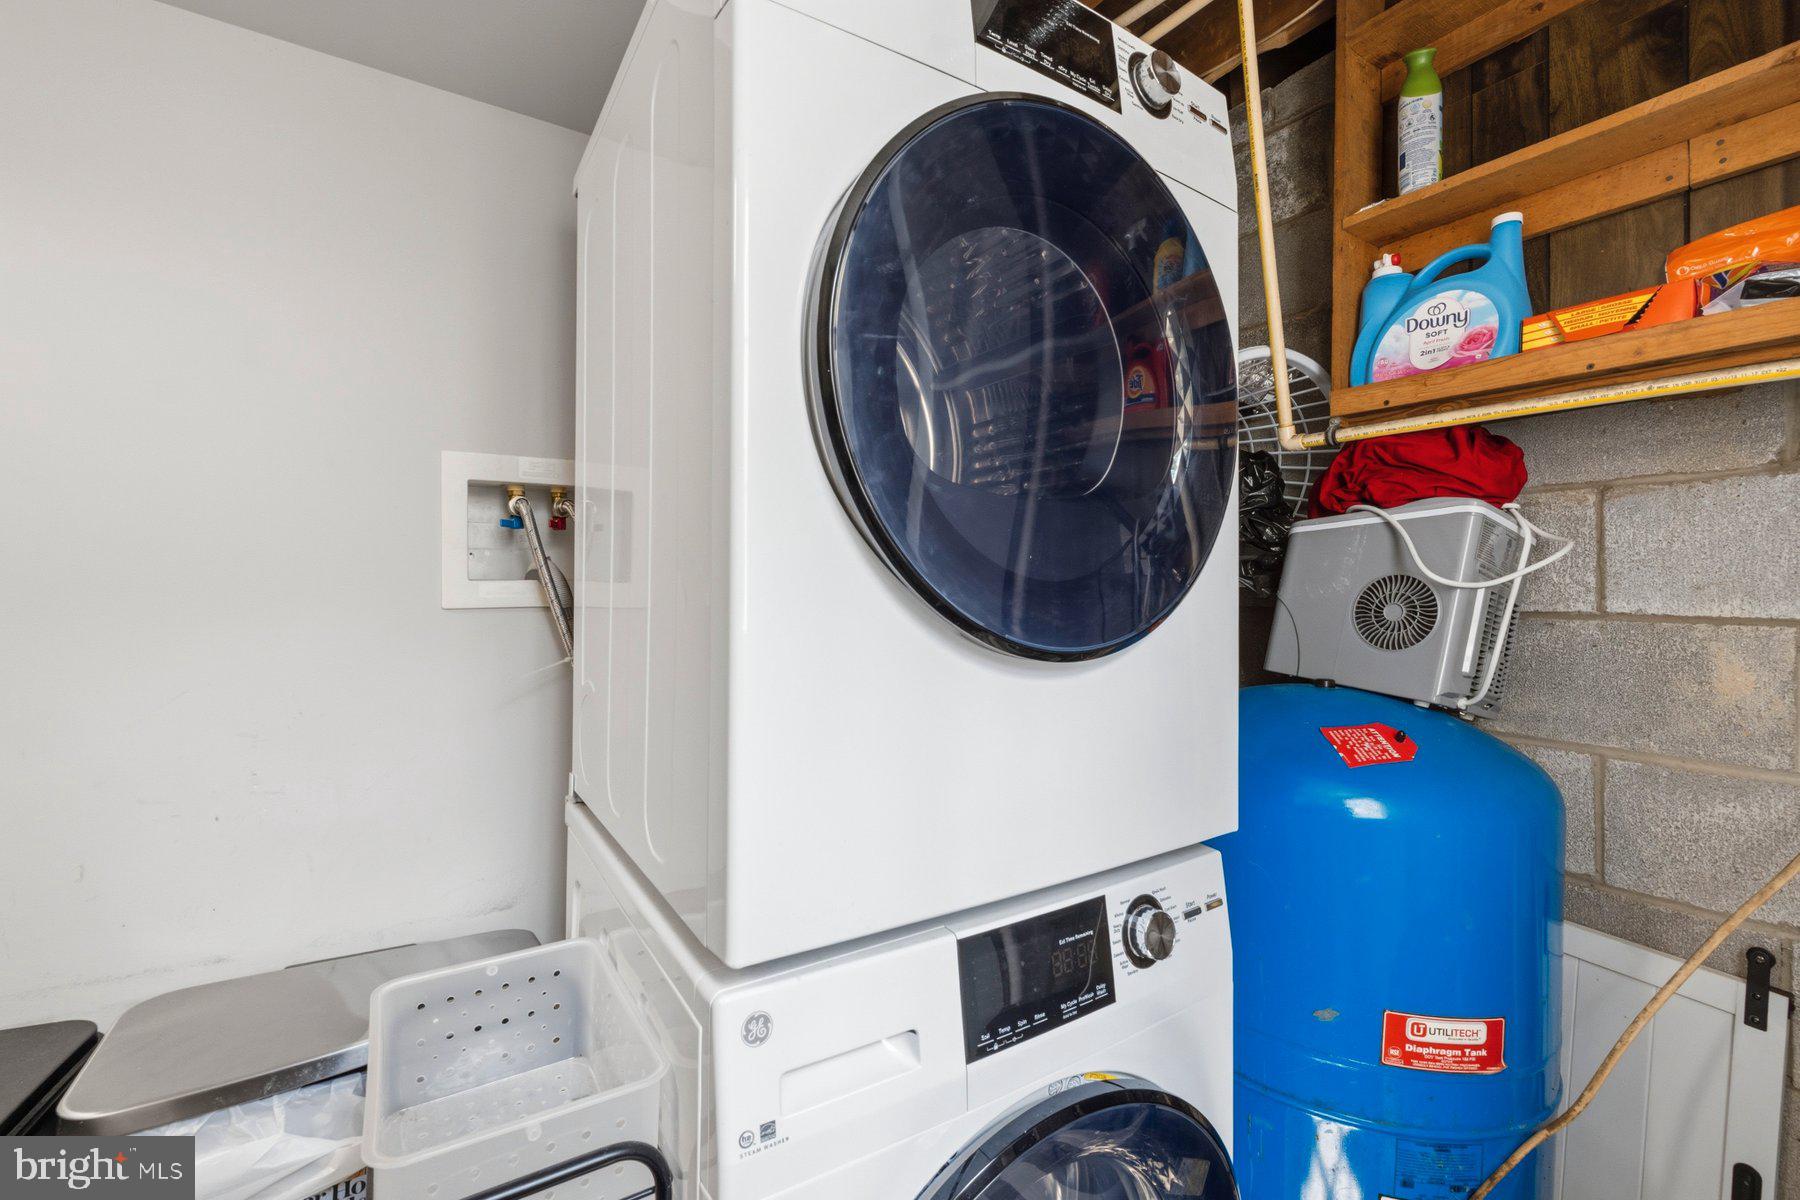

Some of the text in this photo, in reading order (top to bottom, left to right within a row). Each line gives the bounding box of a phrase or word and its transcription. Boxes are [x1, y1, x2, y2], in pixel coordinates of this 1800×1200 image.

[1406, 310, 1469, 333] Downy
[1425, 329, 1448, 338] SOFT
[1420, 347, 1436, 356] 2in1
[1067, 999, 1078, 1007] Cycle
[1034, 1012, 1046, 1020] Rinse
[744, 1014, 770, 1042] GE
[1017, 1019, 1028, 1028] Spin
[998, 1026, 1011, 1035] Temp
[1428, 1027, 1479, 1038] UTILITECH
[981, 1032, 990, 1041] Soil
[1405, 1043, 1488, 1057] Diaphragm Tank
[740, 1136, 790, 1160] STEAM WASHER
